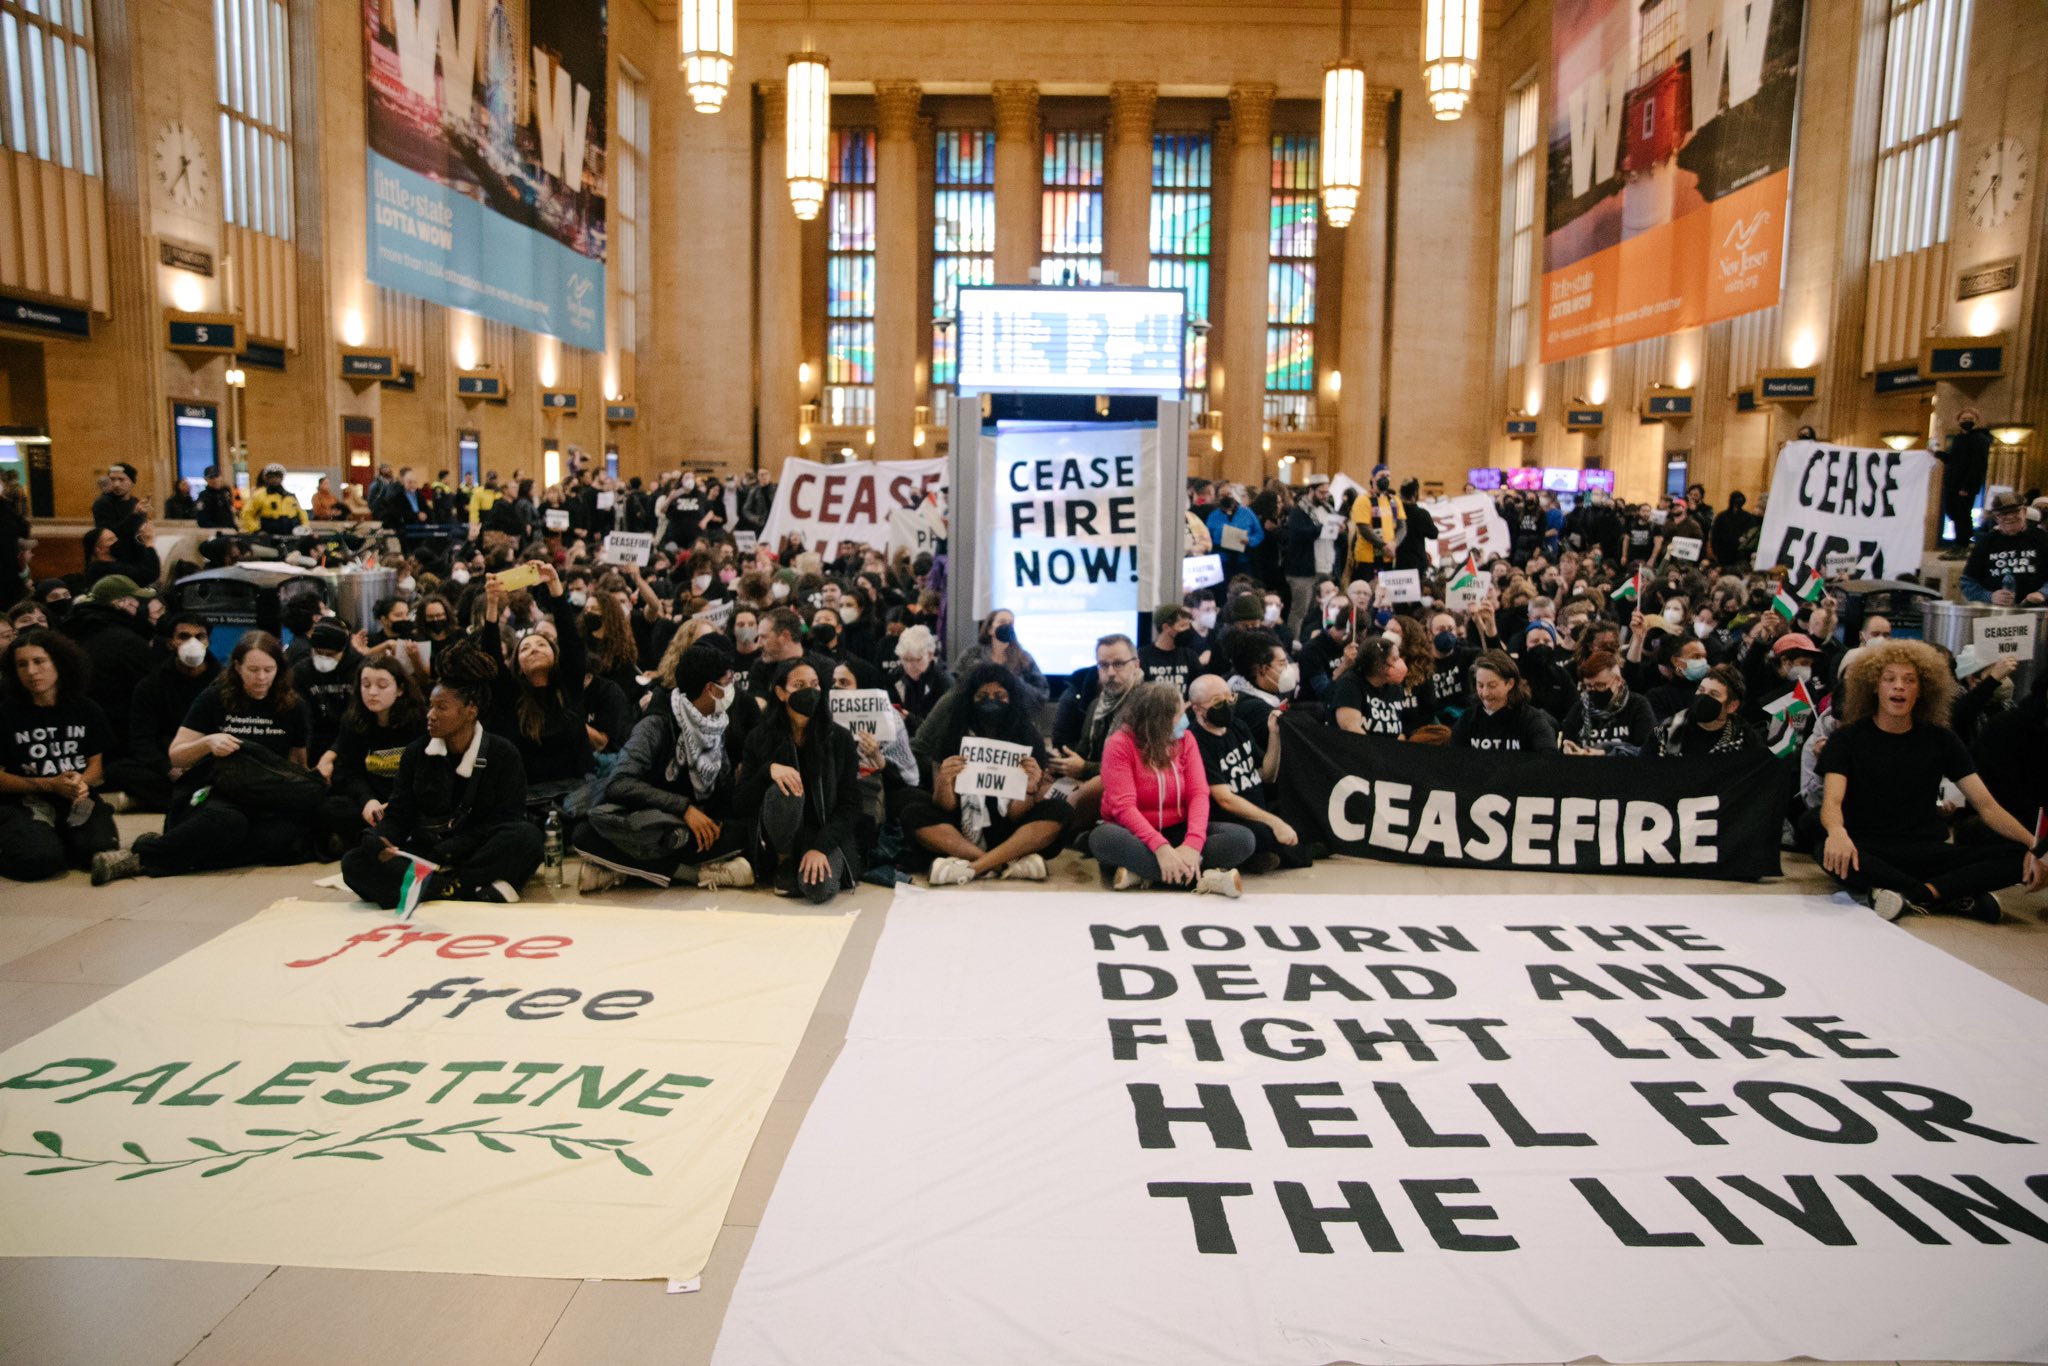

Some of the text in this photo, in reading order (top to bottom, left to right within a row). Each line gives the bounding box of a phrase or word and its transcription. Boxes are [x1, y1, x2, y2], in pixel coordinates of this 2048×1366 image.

[415, 194, 453, 228] state
[376, 203, 453, 250] LOTTA WOW
[195, 326, 209, 343] 5
[1959, 353, 1973, 369] 6
[474, 380, 483, 392] 3
[1768, 382, 1809, 392] Food Court
[1665, 399, 1675, 411] 4
[1009, 456, 1134, 492] CEASE
[1799, 449, 1902, 517] CEASE
[1011, 496, 1136, 538] FIRE
[610, 536, 650, 548] CEASEFIRE
[620, 552, 638, 562] NOW
[1990, 549, 2036, 561] NOT IN
[1995, 558, 2030, 568] OUR
[1014, 545, 1139, 587] NOW!
[1985, 625, 2028, 638] CEASEFIRE
[1998, 642, 2018, 653] NOW
[734, 671, 749, 681] OT
[1149, 665, 1188, 675] NOT IN
[226, 714, 273, 726] Palestinians
[849, 721, 877, 735] NOW
[15, 725, 86, 744] NOT IN
[253, 726, 264, 736] be
[1613, 725, 1629, 737] IN
[29, 740, 78, 759] OUR
[1470, 737, 1520, 750] NOT IN
[976, 773, 1006, 791] NOW
[1328, 774, 1720, 866] CEASEFIRE
[285, 924, 574, 968] free
[1089, 924, 1726, 952] MOURN THE
[1097, 961, 1787, 1001] DEAD AND
[345, 976, 655, 1029] free
[1107, 1016, 1901, 1062] FIGHT LIKE
[0, 1057, 715, 1118] PALESTINE
[1125, 1079, 2040, 1151] HELL FOR
[1146, 1173, 2048, 1255] THE LIVIN
